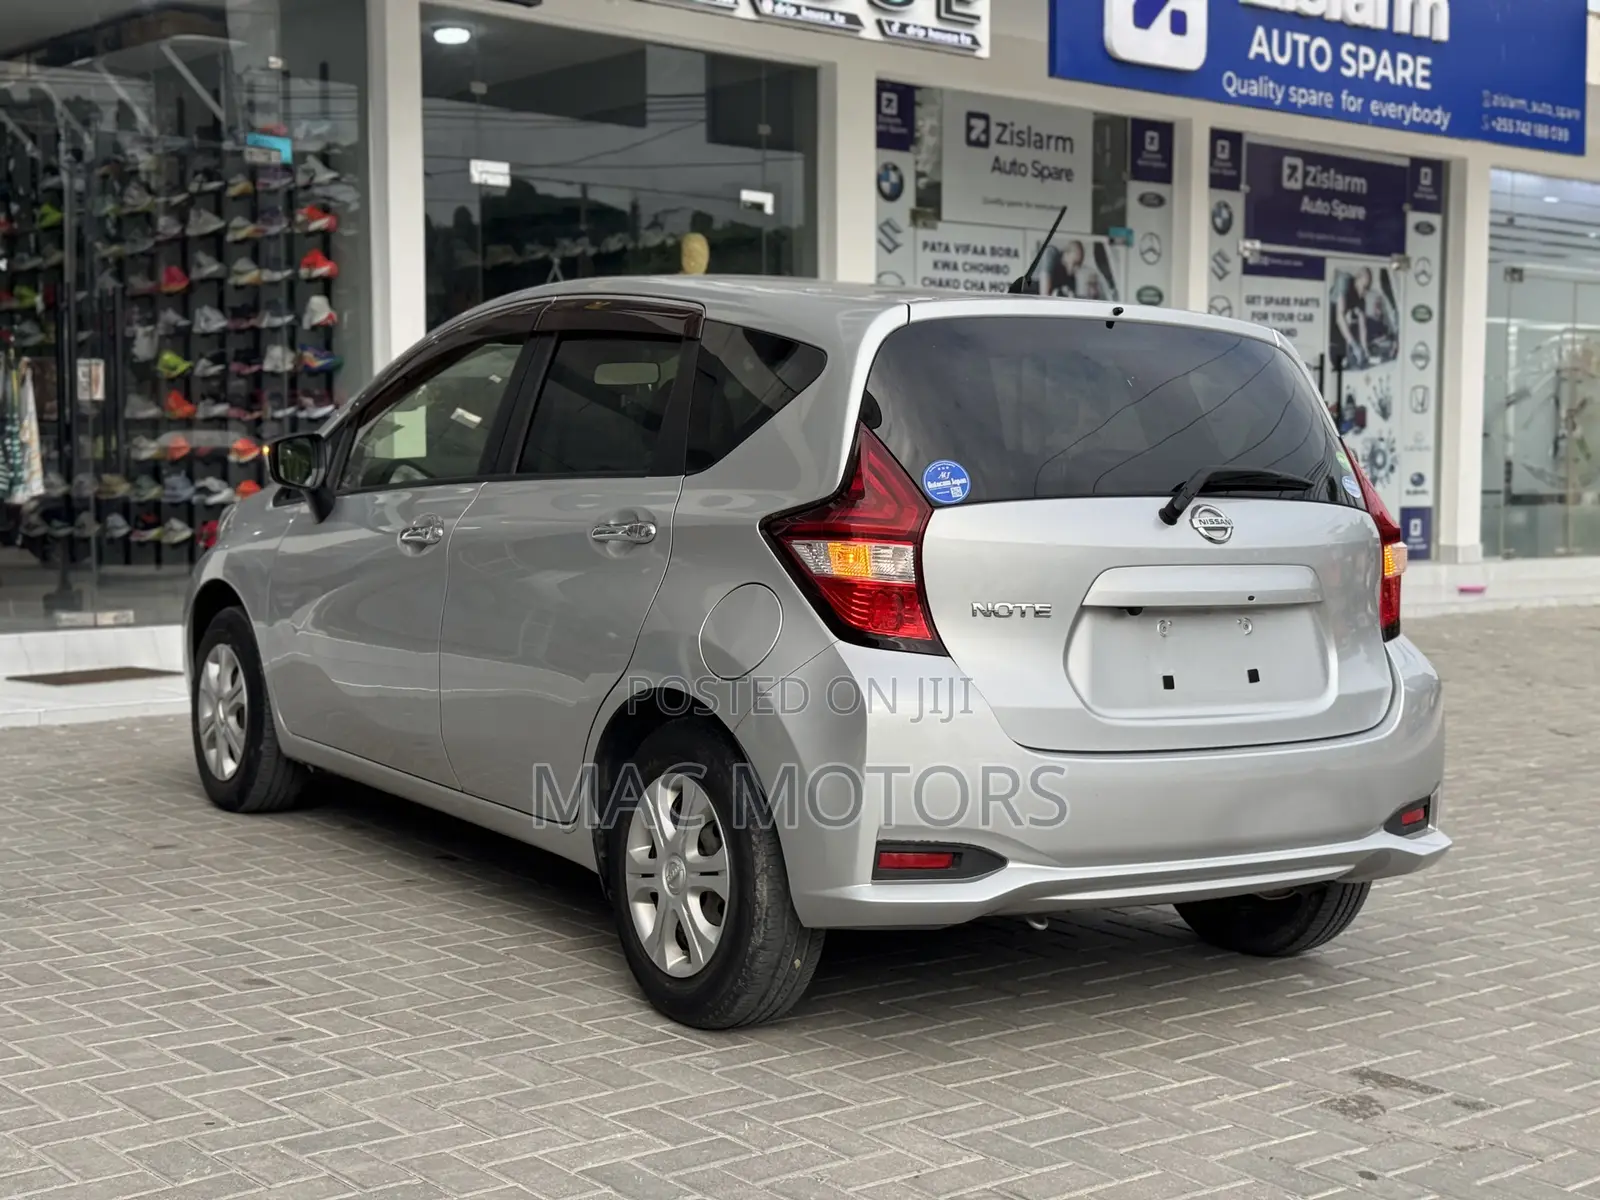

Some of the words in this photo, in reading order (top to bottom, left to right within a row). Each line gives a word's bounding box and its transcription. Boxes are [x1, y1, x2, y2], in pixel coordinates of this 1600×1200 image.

[1248, 25, 1332, 73] AUTO
[1340, 42, 1433, 90] SPARE
[1222, 71, 1286, 105] Quality
[1288, 84, 1334, 108] spare
[1341, 89, 1364, 113] for
[1370, 98, 1452, 131] everybody
[995, 121, 1074, 155] Zislarm
[991, 155, 1028, 178] Auto
[1030, 160, 1075, 184] Spare
[1305, 165, 1368, 195] Zislarm
[1300, 195, 1330, 216] Auto
[1331, 198, 1367, 221] Spare
[922, 241, 951, 253] PATA
[953, 242, 987, 256] VIFAA
[989, 245, 1019, 258] BORA
[932, 260, 959, 272] KWA
[961, 262, 1010, 276] CHOMBO
[1199, 518, 1232, 526] NISSAN
[971, 601, 1052, 618] NOTE
